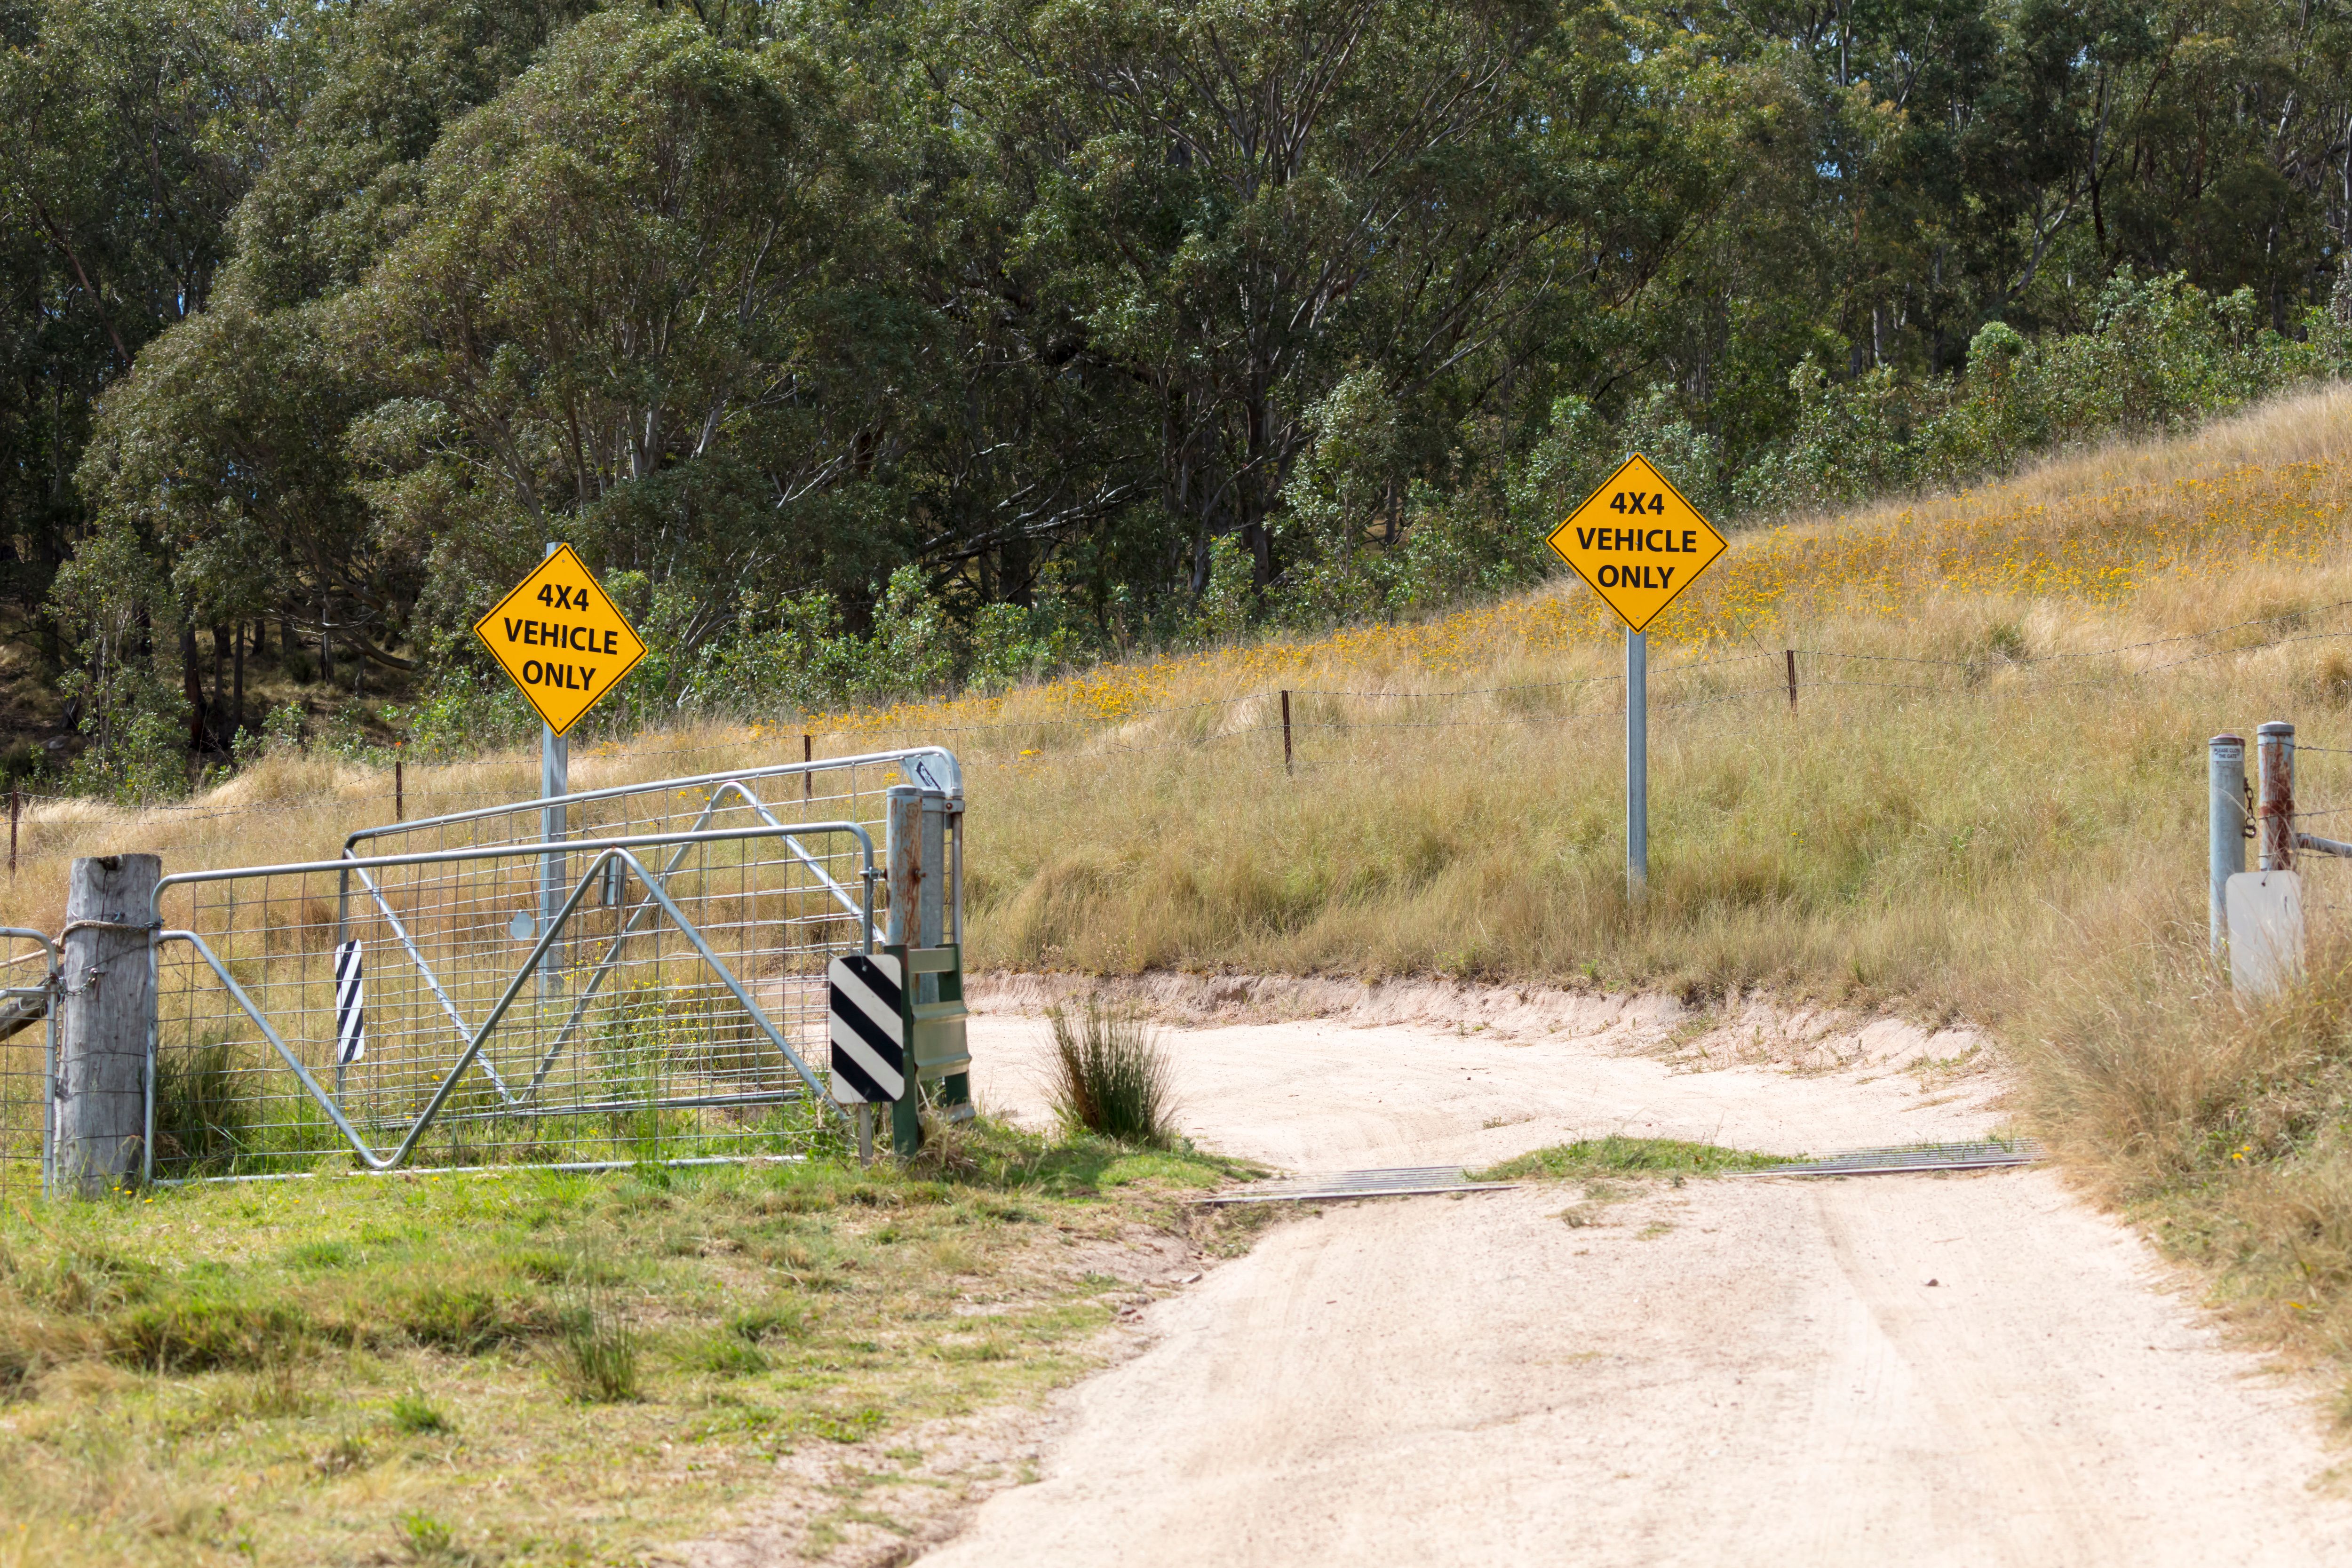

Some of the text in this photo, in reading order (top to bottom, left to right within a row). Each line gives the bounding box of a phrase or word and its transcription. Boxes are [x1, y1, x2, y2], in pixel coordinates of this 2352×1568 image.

[1610, 492, 1665, 515] 4X4
[1576, 527, 1697, 553] VEHICLE
[1597, 565, 1675, 589] ONLY
[537, 584, 589, 612] 4X4
[504, 617, 618, 655] VEHICLE
[523, 660, 596, 691] ONLY
